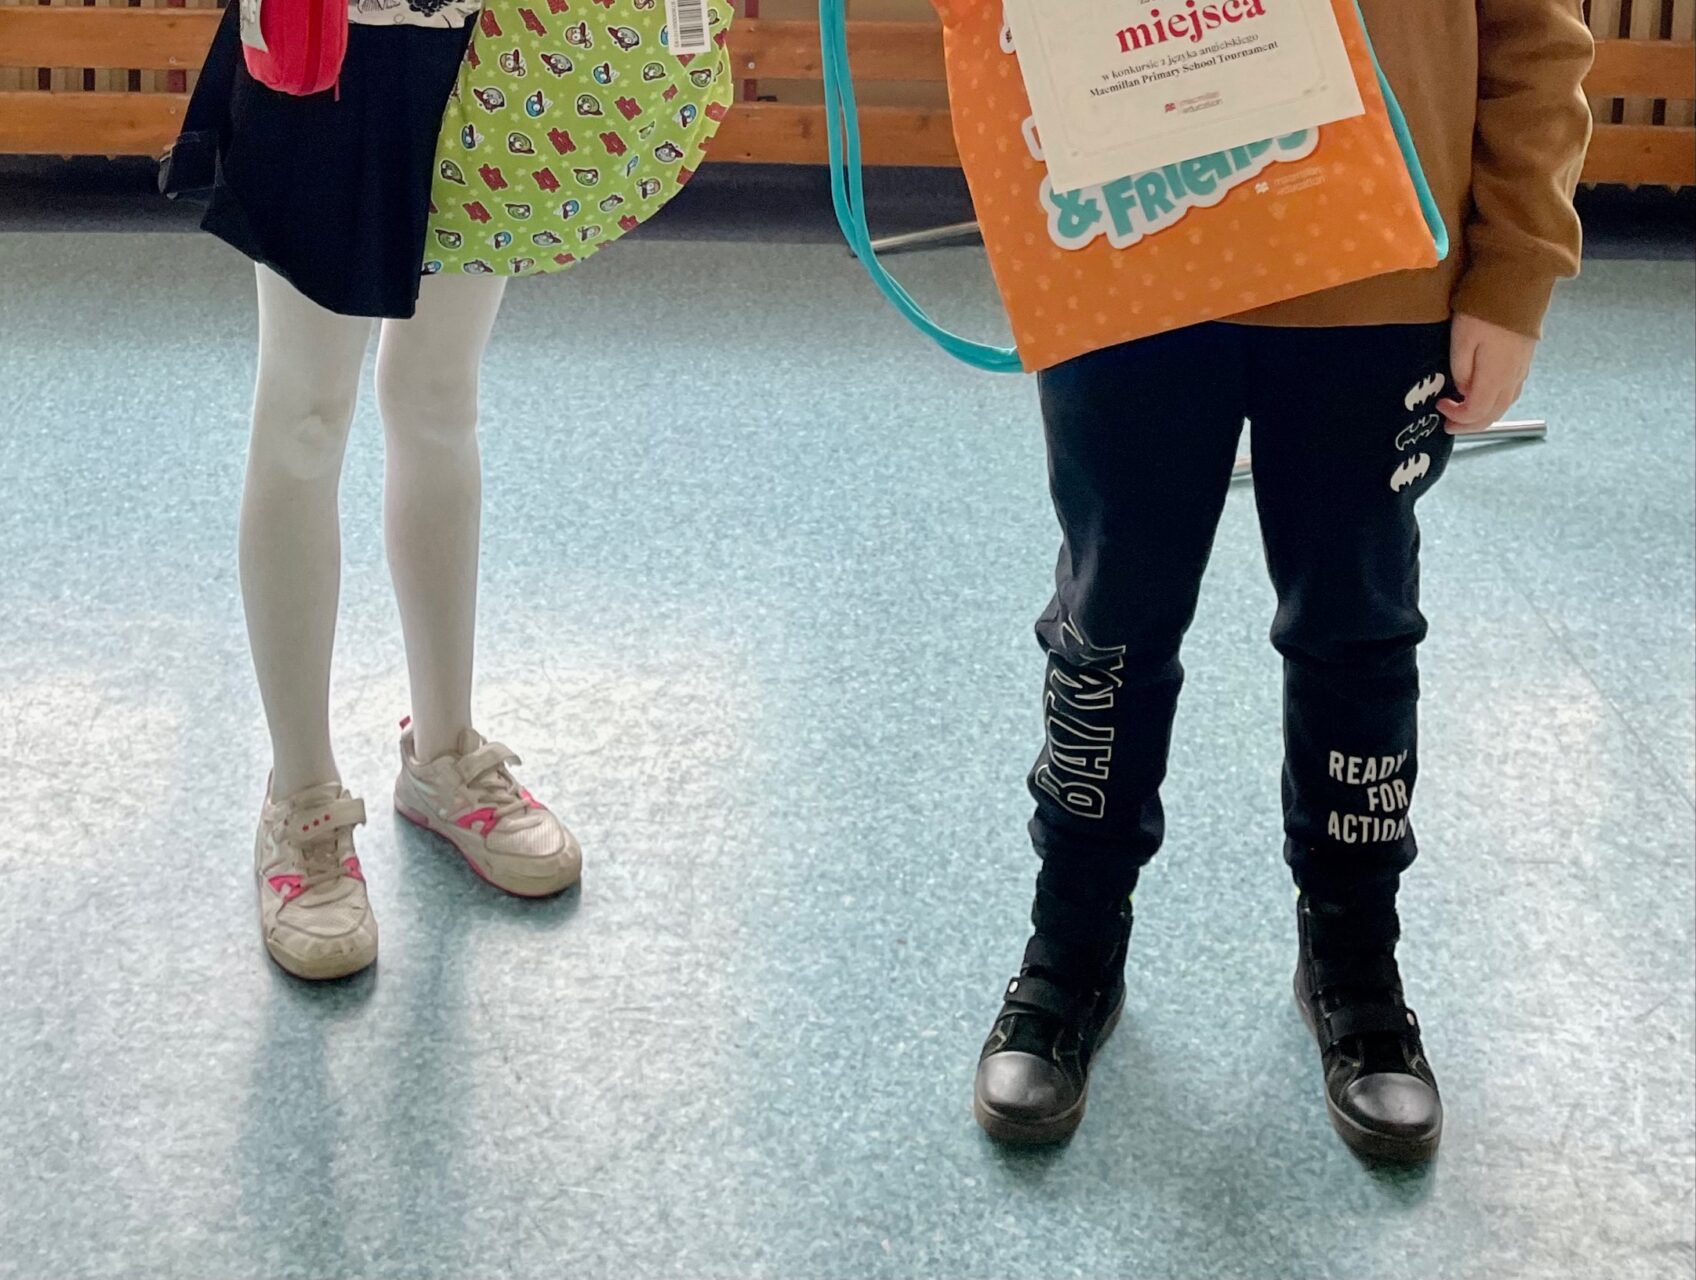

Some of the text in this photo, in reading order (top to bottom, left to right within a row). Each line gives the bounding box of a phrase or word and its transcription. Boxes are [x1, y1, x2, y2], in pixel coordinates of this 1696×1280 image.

[1089, 40, 1279, 98] Macmillan Primary School Tournament
[1101, 73, 1110, 82] w
[1111, 60, 1159, 79] konkursie
[1167, 48, 1198, 68] języka
[1198, 33, 1259, 57] angielskiego
[1050, 188, 1102, 238] &
[1035, 612, 1127, 819] BATMN
[1328, 748, 1408, 785] READY
[1367, 778, 1409, 813] FOR
[1328, 810, 1408, 844] ACTION
